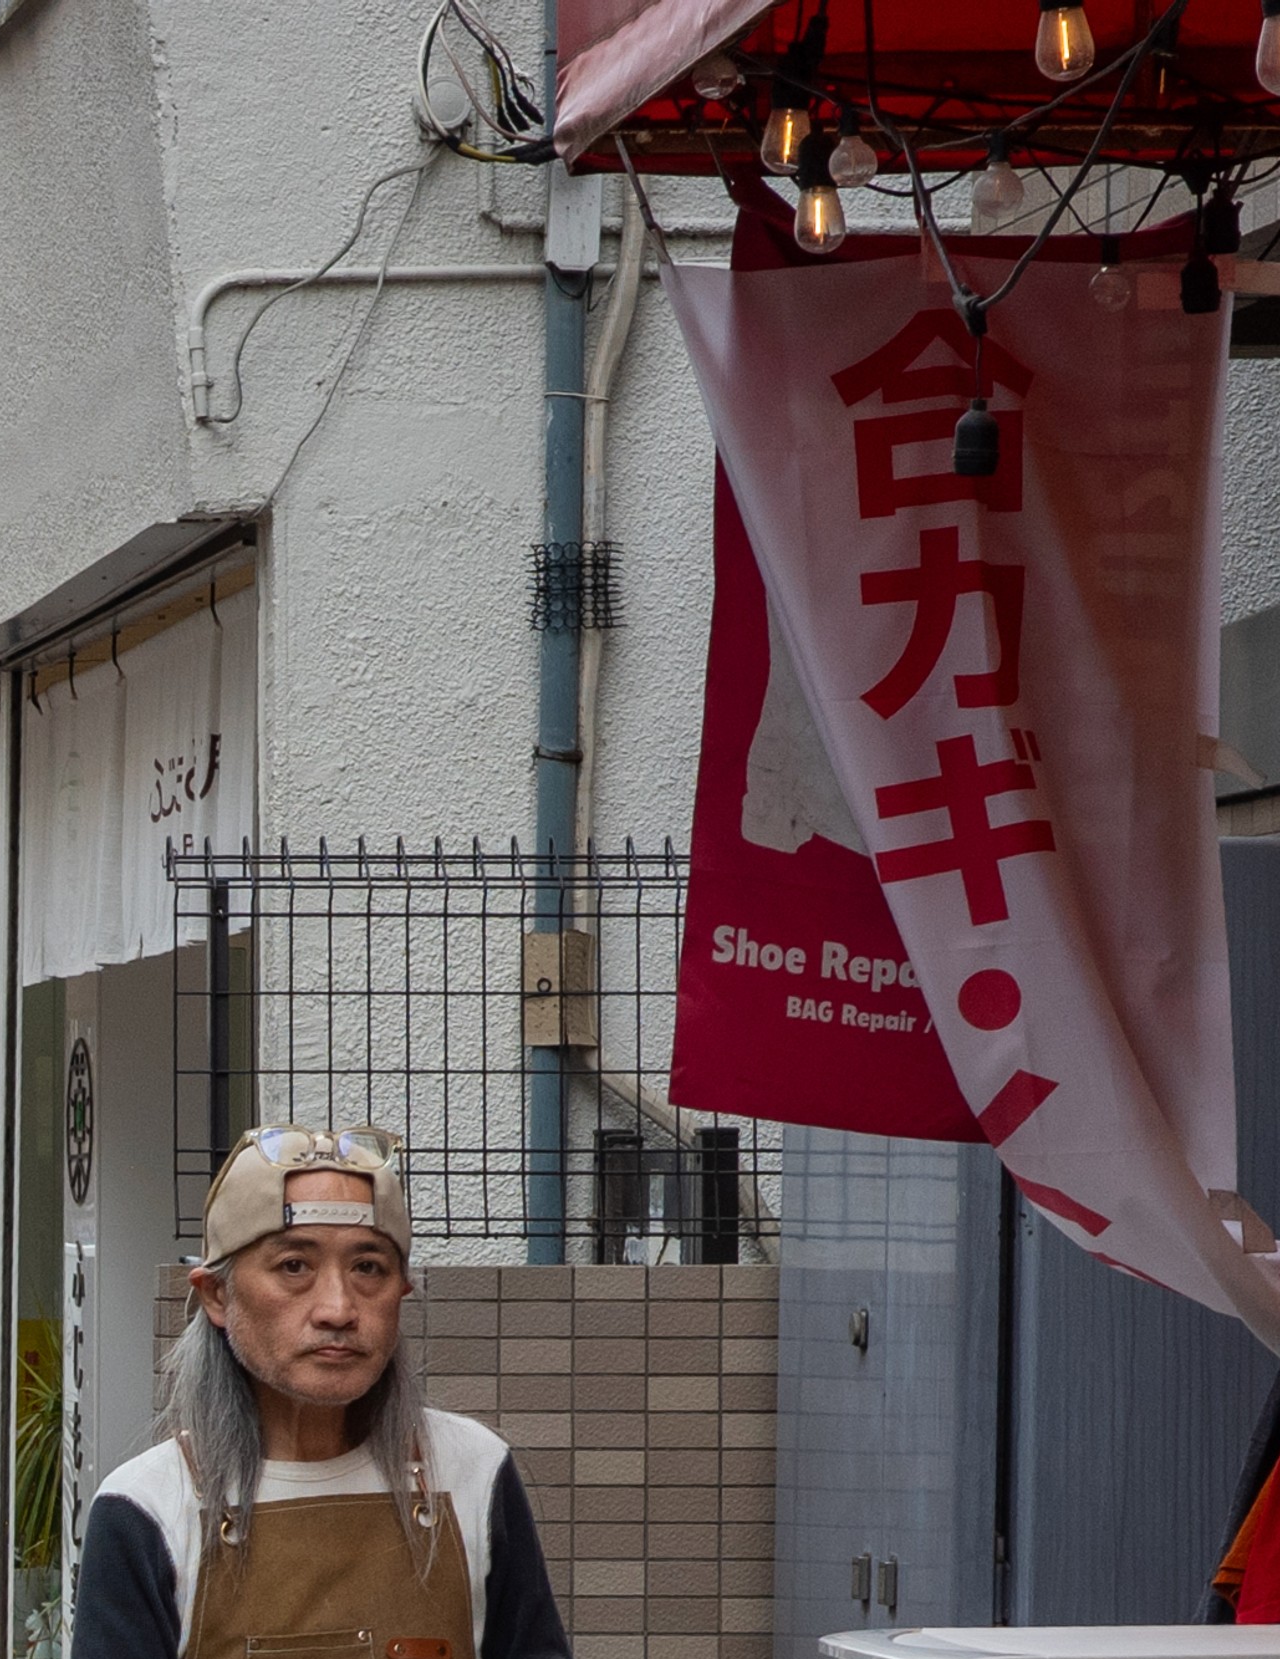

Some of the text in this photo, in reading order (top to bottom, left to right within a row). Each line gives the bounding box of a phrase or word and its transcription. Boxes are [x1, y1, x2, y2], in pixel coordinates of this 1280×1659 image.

[712, 924, 807, 975] Shoe
[786, 995, 833, 1023] BAG
[841, 1003, 917, 1033] Repair
